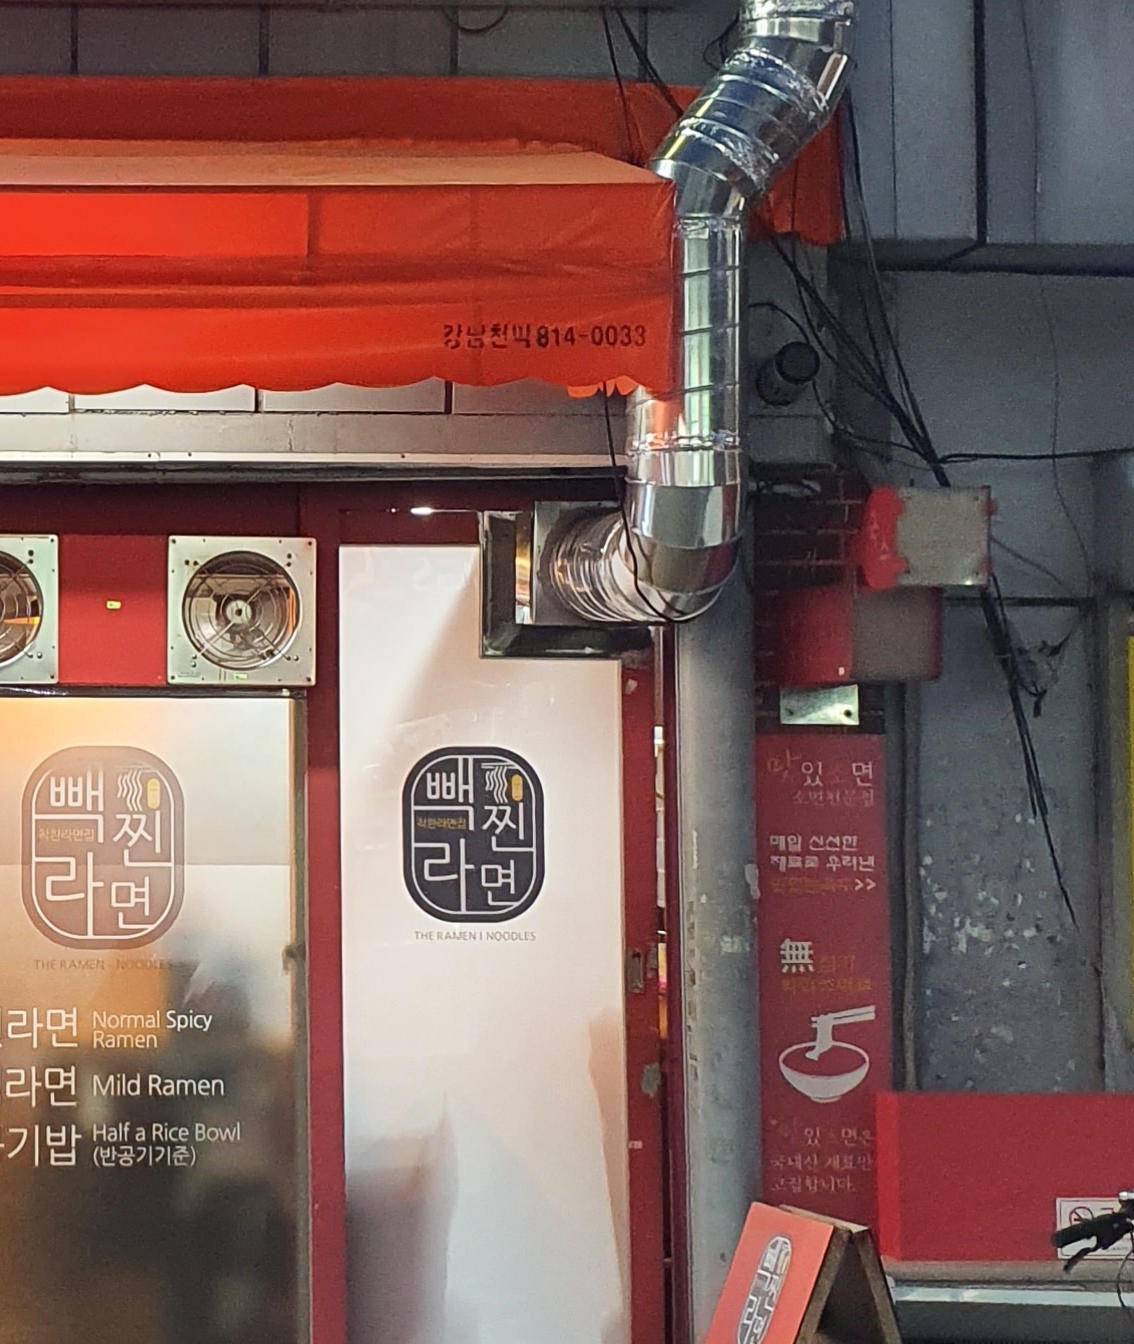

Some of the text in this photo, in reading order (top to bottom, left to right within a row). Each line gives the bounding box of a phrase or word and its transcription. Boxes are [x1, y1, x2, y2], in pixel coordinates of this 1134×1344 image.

[536, 325, 647, 347] 814-0033
[769, 834, 859, 852] 매일 신선한
[415, 931, 537, 942] THE RAMEN NOODLES
[34, 959, 56, 970] THE
[59, 959, 105, 970] RAMEN
[92, 1010, 213, 1032] Normal Spicy
[92, 1031, 158, 1049] Ramen
[92, 1073, 225, 1096] Mild Ramen
[92, 1121, 242, 1142] Half a Rice Bowl
[92, 1145, 197, 1167] (반공기기준)
